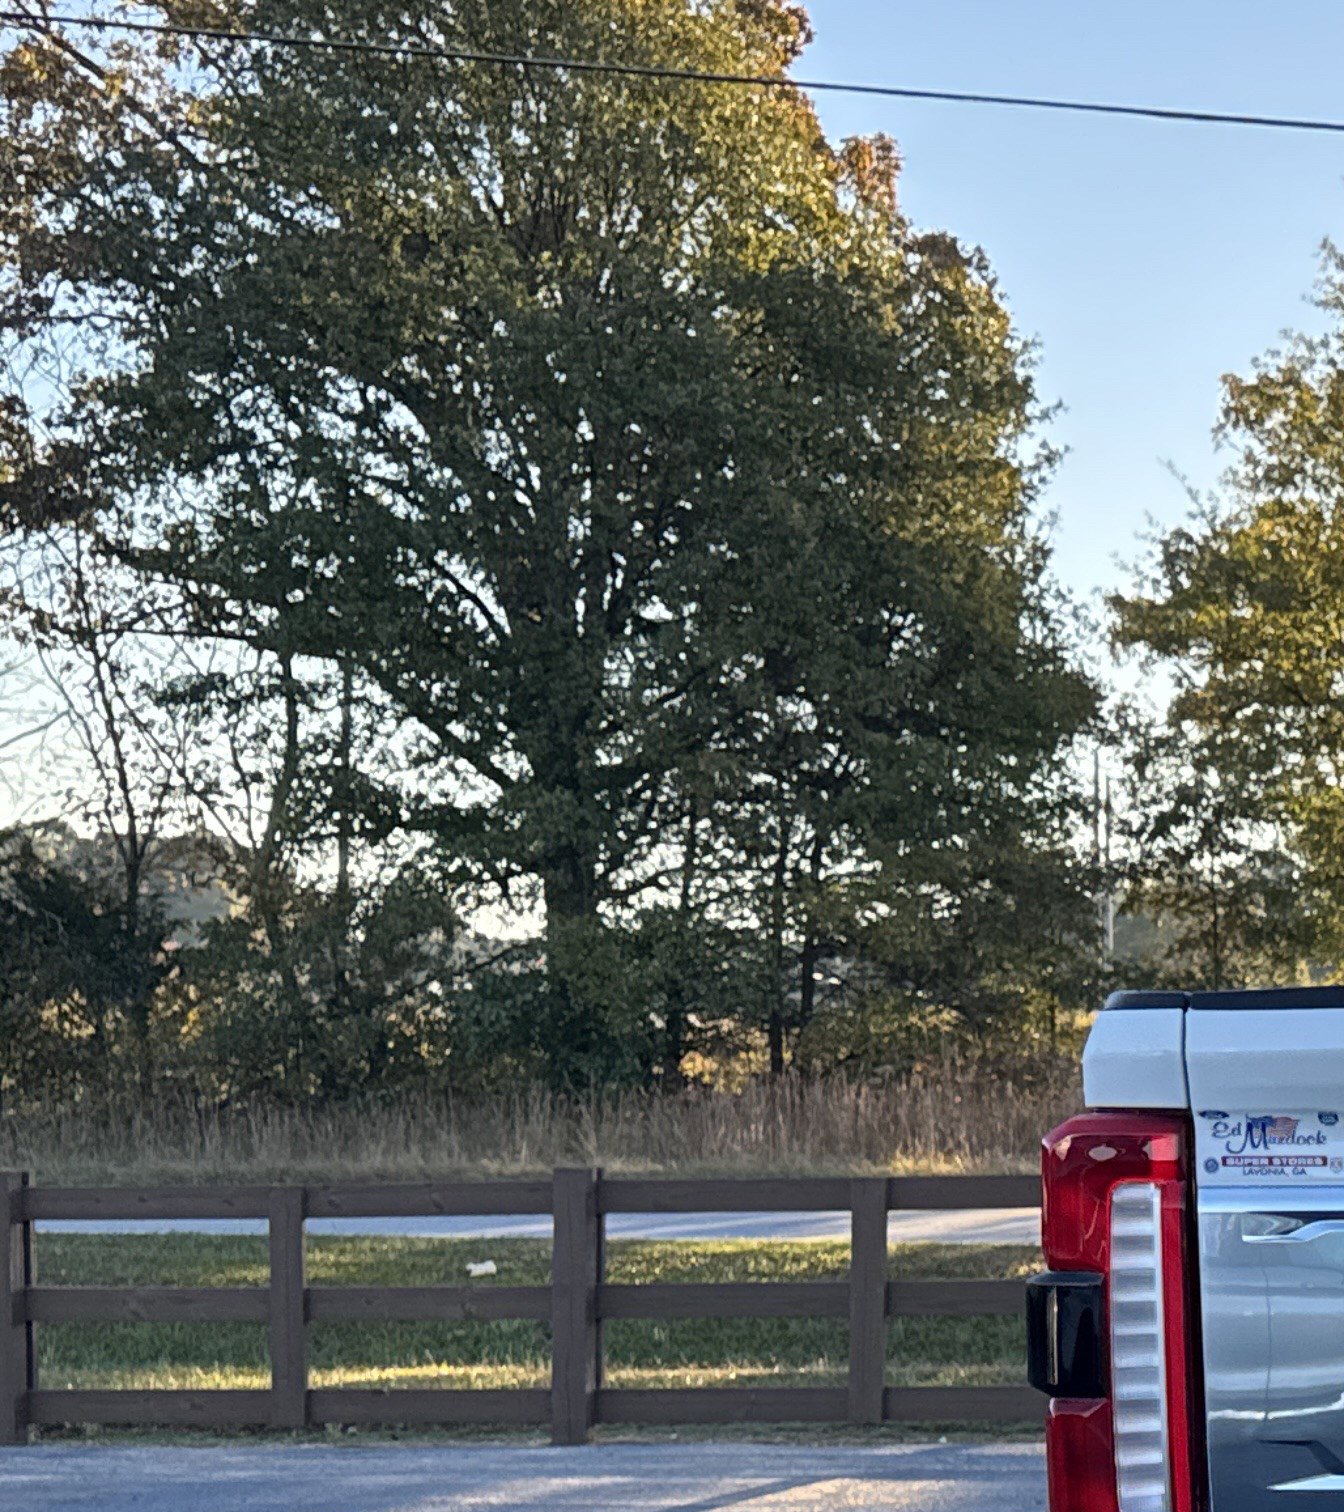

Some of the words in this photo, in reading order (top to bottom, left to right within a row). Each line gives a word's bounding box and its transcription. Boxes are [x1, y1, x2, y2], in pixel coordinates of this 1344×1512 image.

[1212, 1121, 1241, 1138] Ed
[1226, 1119, 1327, 1154] Murdock
[1225, 1157, 1269, 1166] SUPER
[1293, 1167, 1307, 1176] GA
